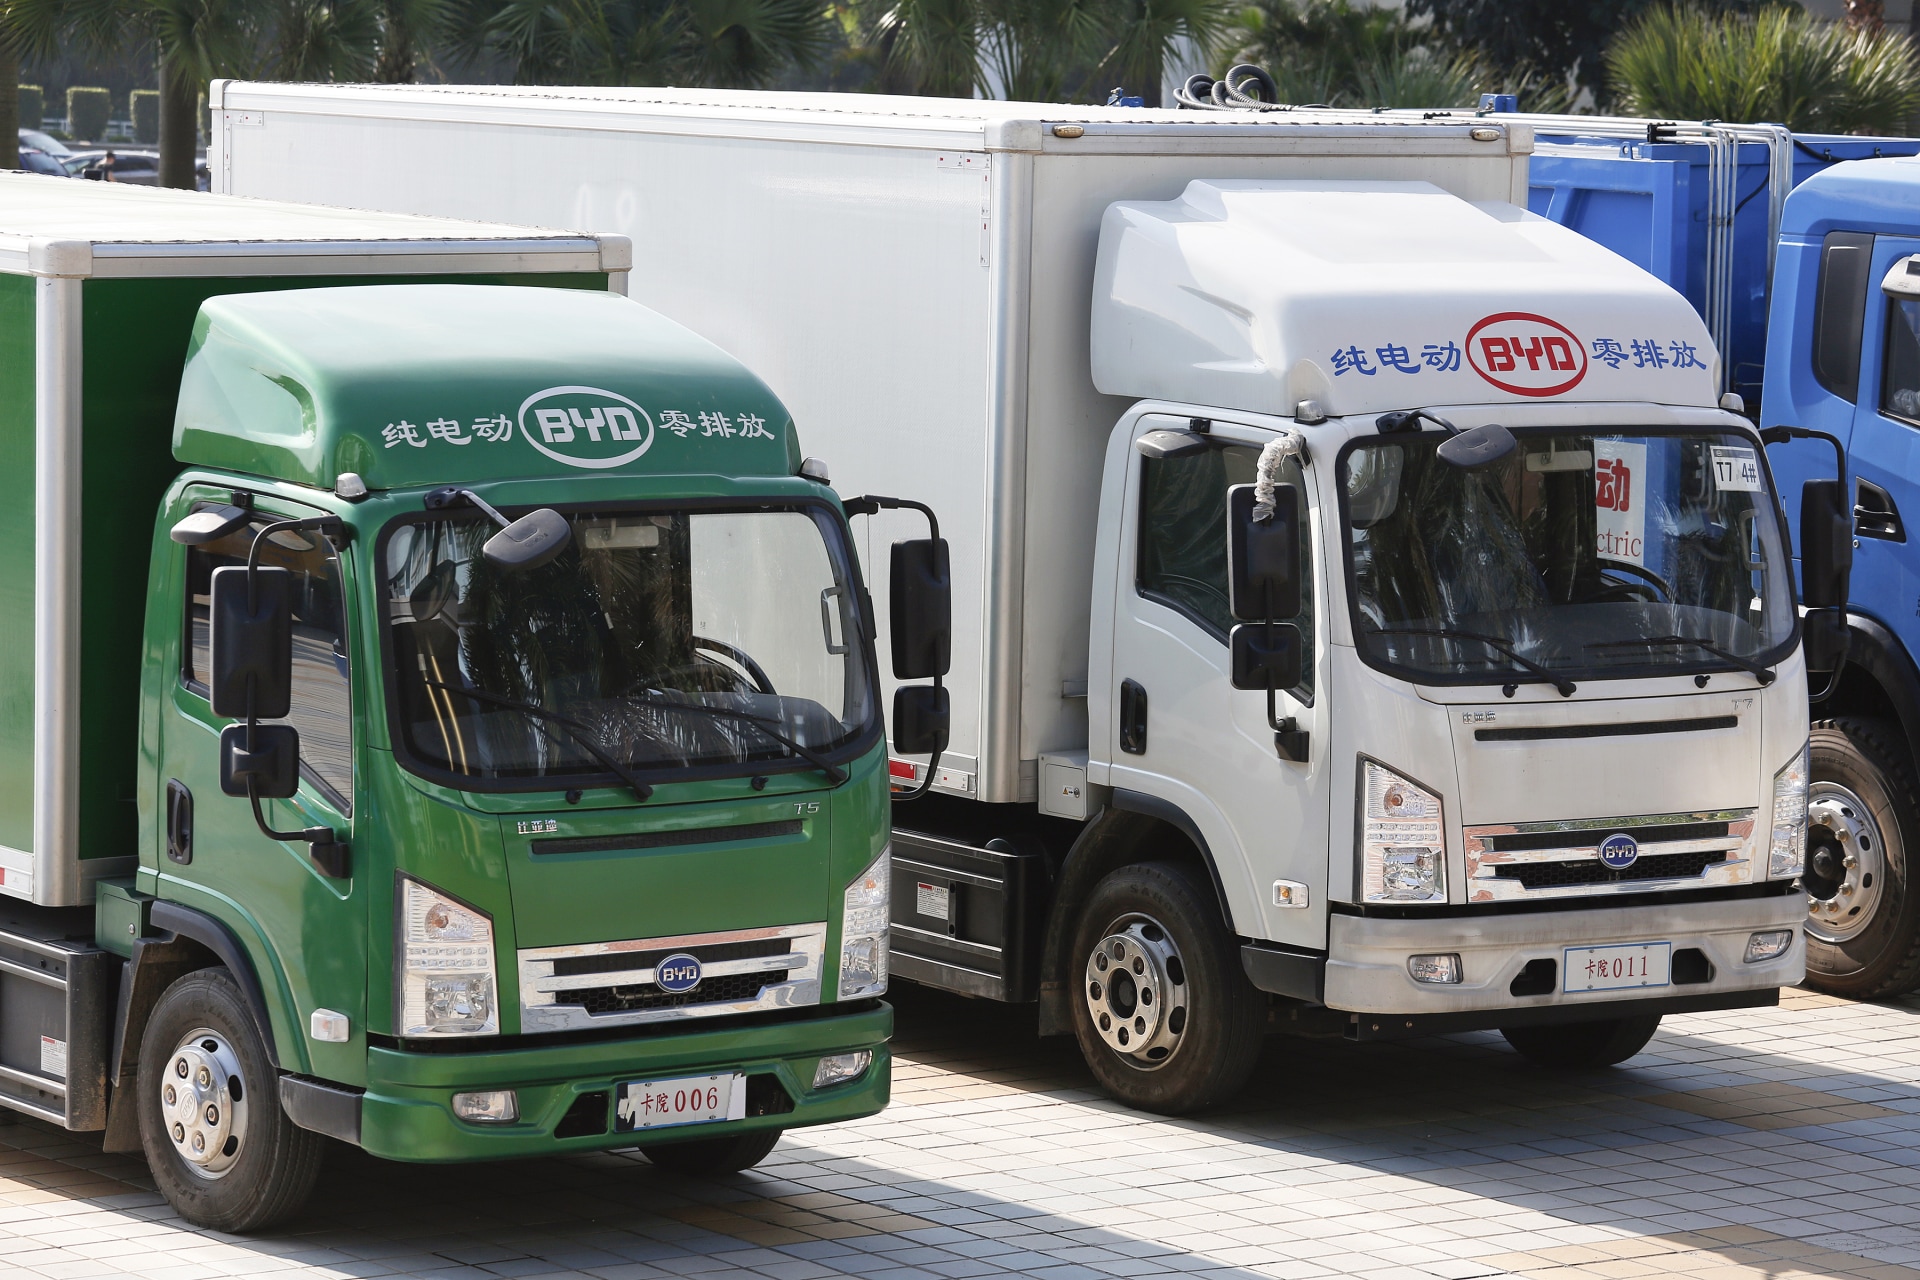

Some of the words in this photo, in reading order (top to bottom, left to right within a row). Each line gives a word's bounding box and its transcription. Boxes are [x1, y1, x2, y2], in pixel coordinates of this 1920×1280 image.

[1330, 340, 1462, 377] 纯电动
[1479, 336, 1577, 372] BYD
[1591, 338, 1707, 370] 零排放
[381, 413, 513, 449] 纯电动
[534, 406, 643, 443] BYD
[658, 409, 776, 440] 零排放
[1595, 458, 1631, 513] 动
[1715, 461, 1733, 482] T7
[1741, 462, 1757, 484] 4#
[793, 801, 820, 815] T5
[1605, 844, 1634, 859] BYD
[662, 965, 697, 982] BYD
